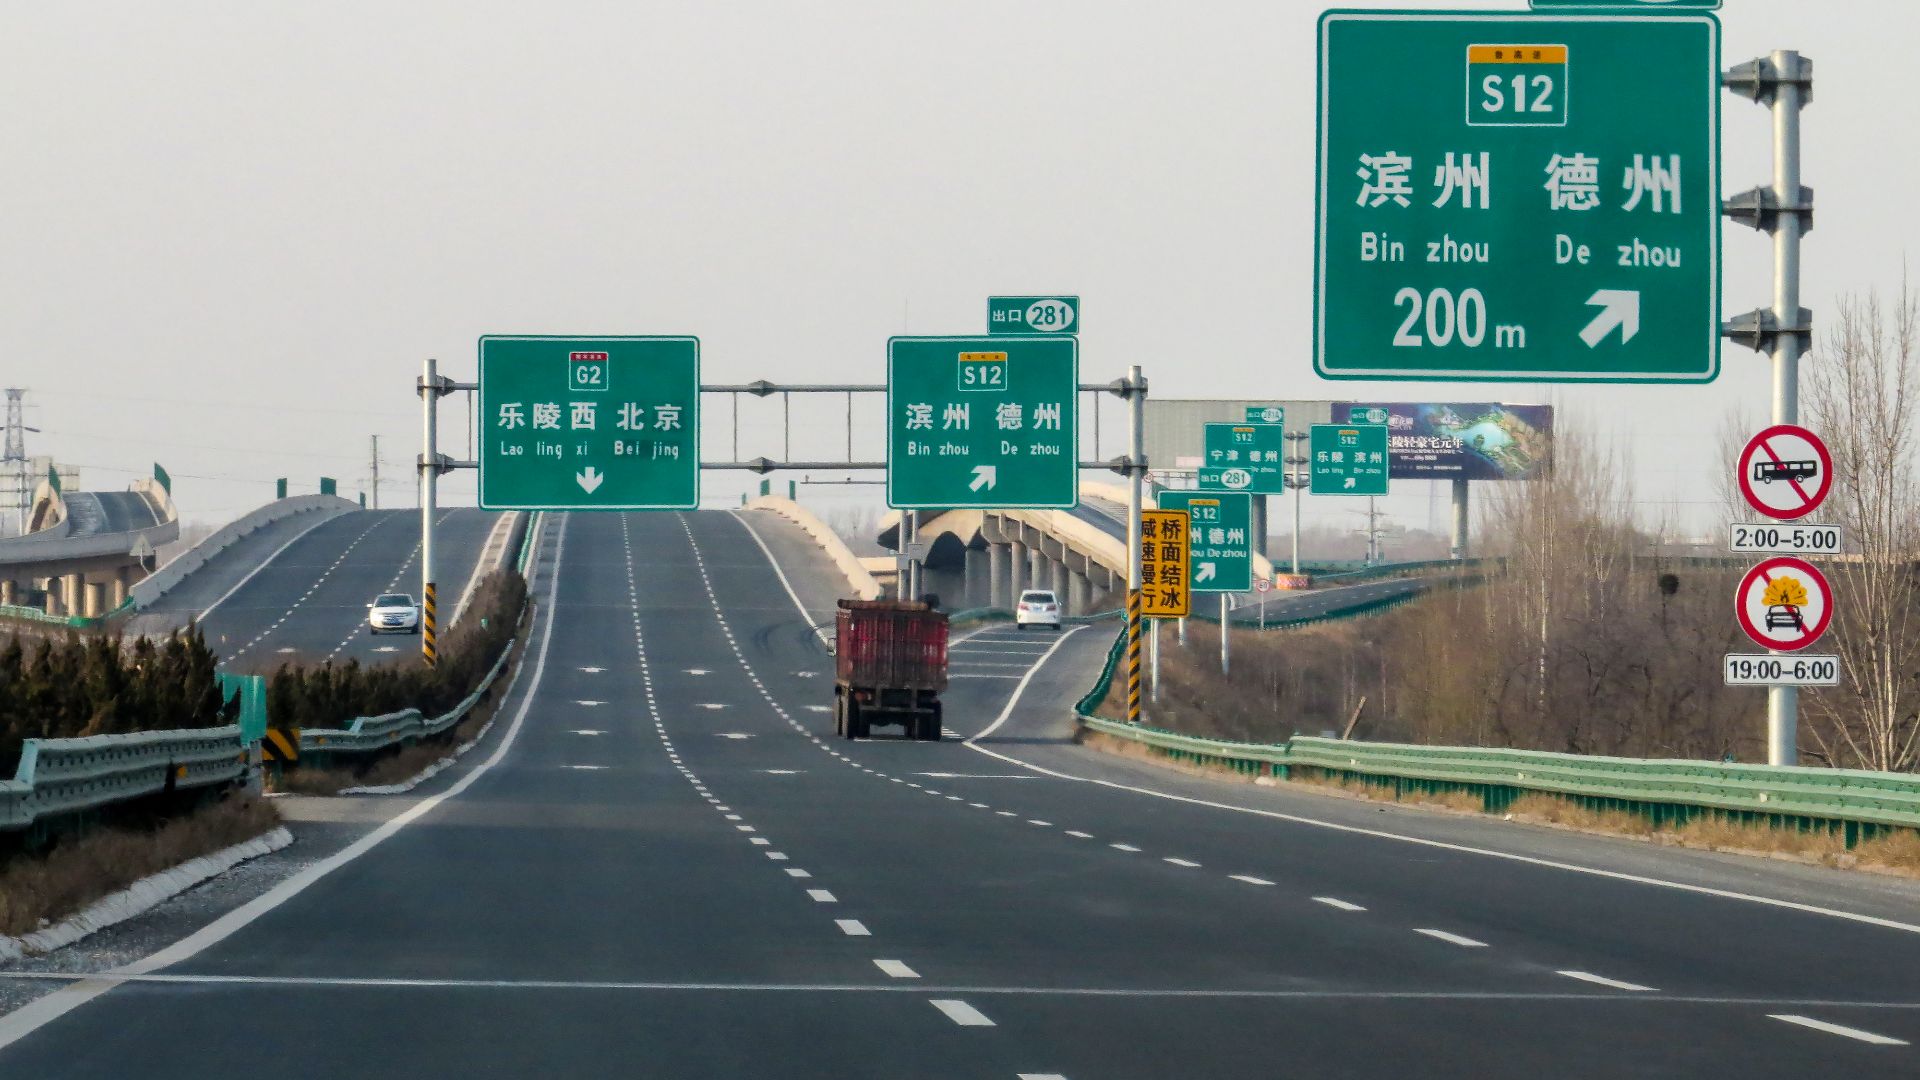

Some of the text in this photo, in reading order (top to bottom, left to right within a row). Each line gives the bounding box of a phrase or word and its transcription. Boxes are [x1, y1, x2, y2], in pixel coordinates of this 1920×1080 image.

[1482, 75, 1552, 112] S12
[1356, 151, 1681, 213] 滨州 德州
[1361, 232, 1680, 267] Bin zhou De zhou
[993, 305, 1067, 326] 出口 281
[577, 366, 600, 383] G2
[964, 366, 1001, 384] S12
[498, 402, 681, 431] 乐陵西 北京
[906, 402, 1060, 430] 滨州 德州
[1236, 433, 1253, 442] S12
[1341, 436, 1357, 445] S12
[501, 440, 678, 460] Lao ling xi Bei jing
[908, 441, 1059, 455] Bin zhou De zhou
[1317, 451, 1343, 463] 乐陵
[1201, 472, 1245, 484] 出口 281
[1193, 507, 1216, 519] S12
[1209, 528, 1243, 544] 德州
[1207, 548, 1221, 558] De
[1222, 549, 1247, 558] zhou
[1160, 519, 1181, 608] 桥面结冰
